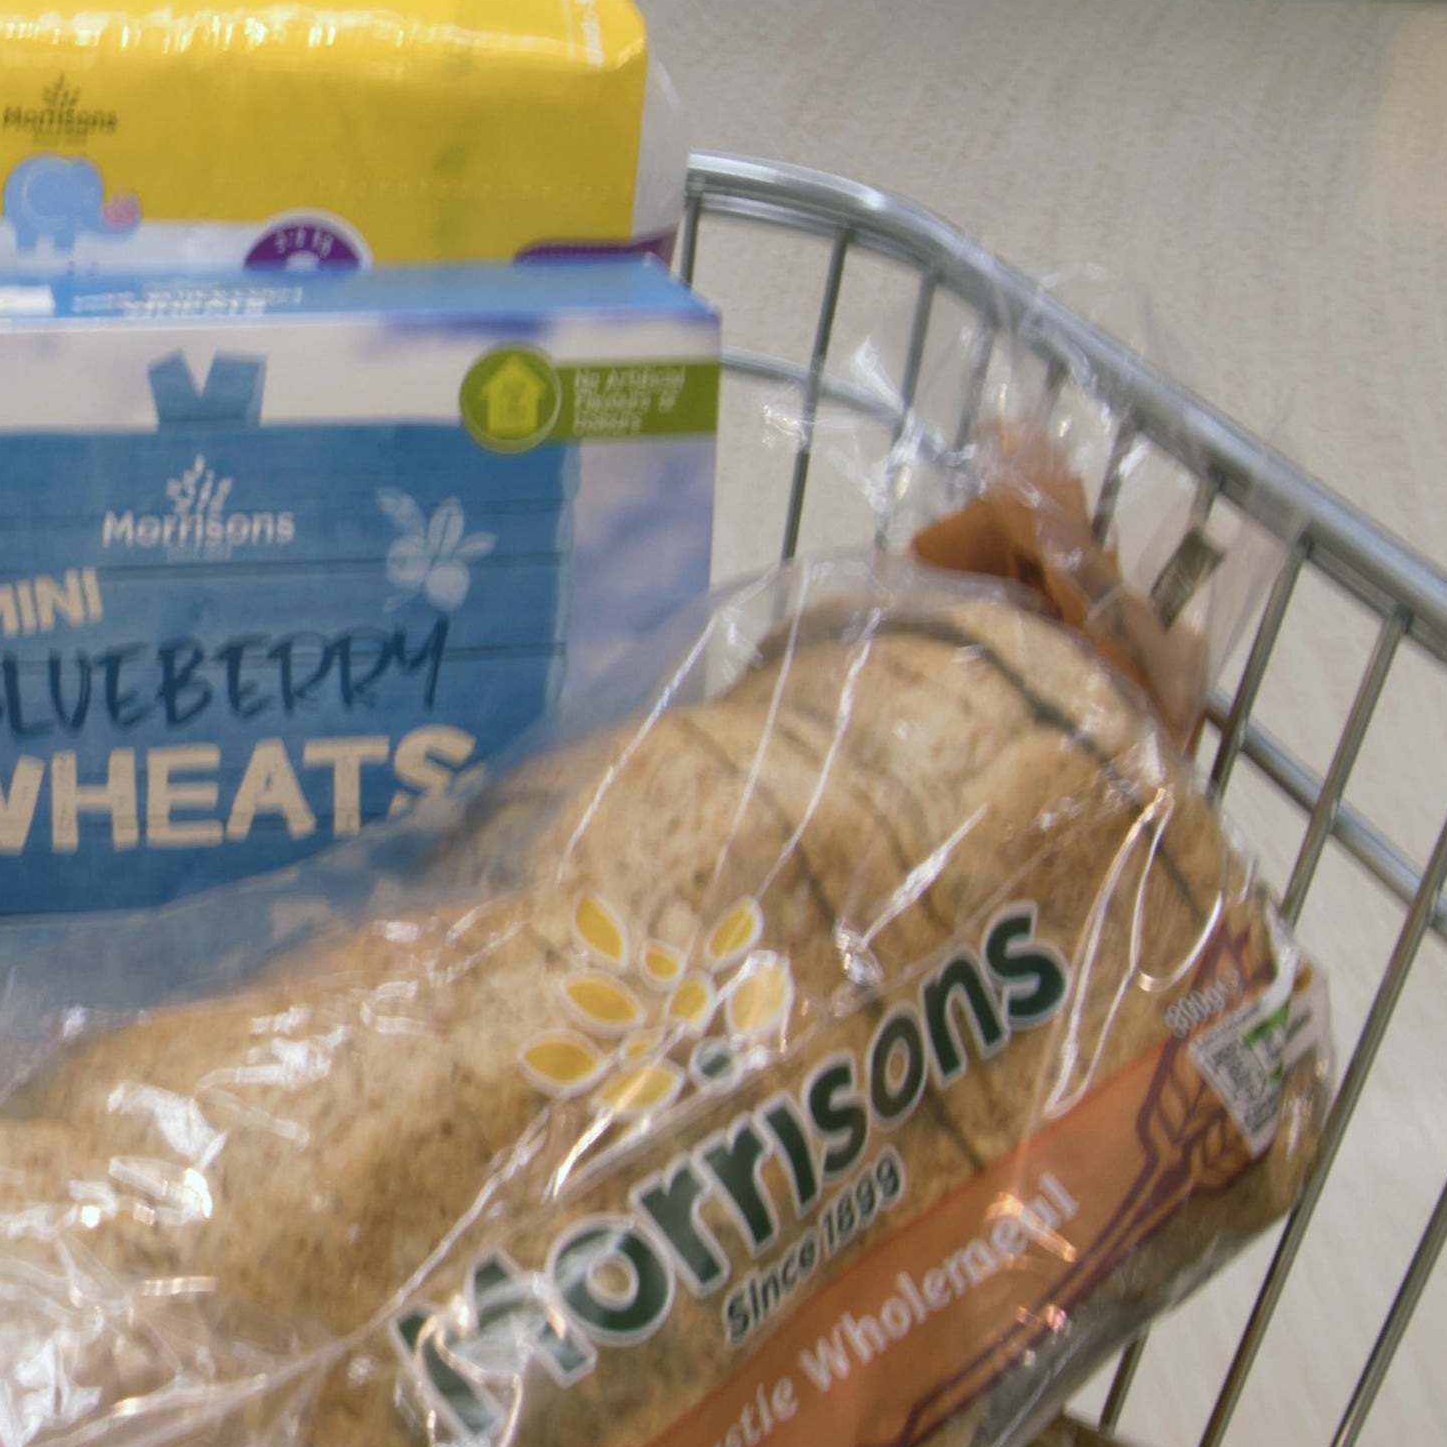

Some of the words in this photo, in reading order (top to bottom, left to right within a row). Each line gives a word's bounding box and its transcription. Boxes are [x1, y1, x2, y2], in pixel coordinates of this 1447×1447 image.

[103, 508, 296, 549] Morrisons
[389, 898, 1071, 1445] Morrisons
[821, 1147, 905, 1261] 1899
[798, 1170, 1080, 1395] Wholemeal
